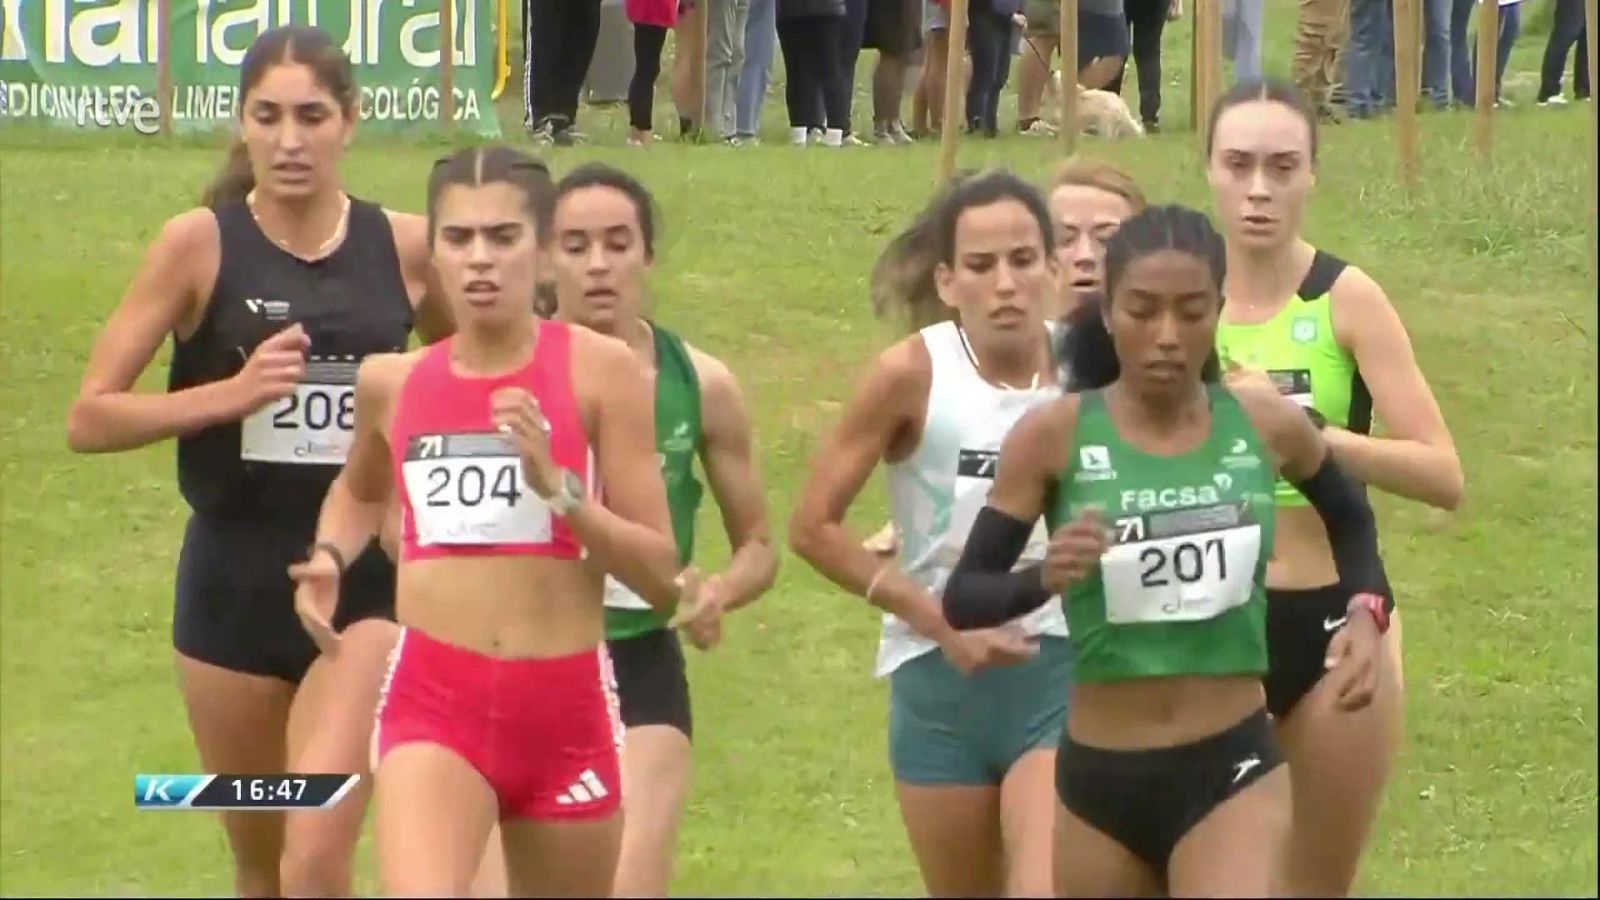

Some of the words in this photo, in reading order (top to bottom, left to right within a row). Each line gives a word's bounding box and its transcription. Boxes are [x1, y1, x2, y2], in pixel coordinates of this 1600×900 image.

[0, 80, 141, 120] DICINALES
[359, 79, 481, 120] COLÓGCA
[273, 391, 355, 430] 208
[427, 465, 522, 507] 204
[1140, 538, 1228, 588] 201
